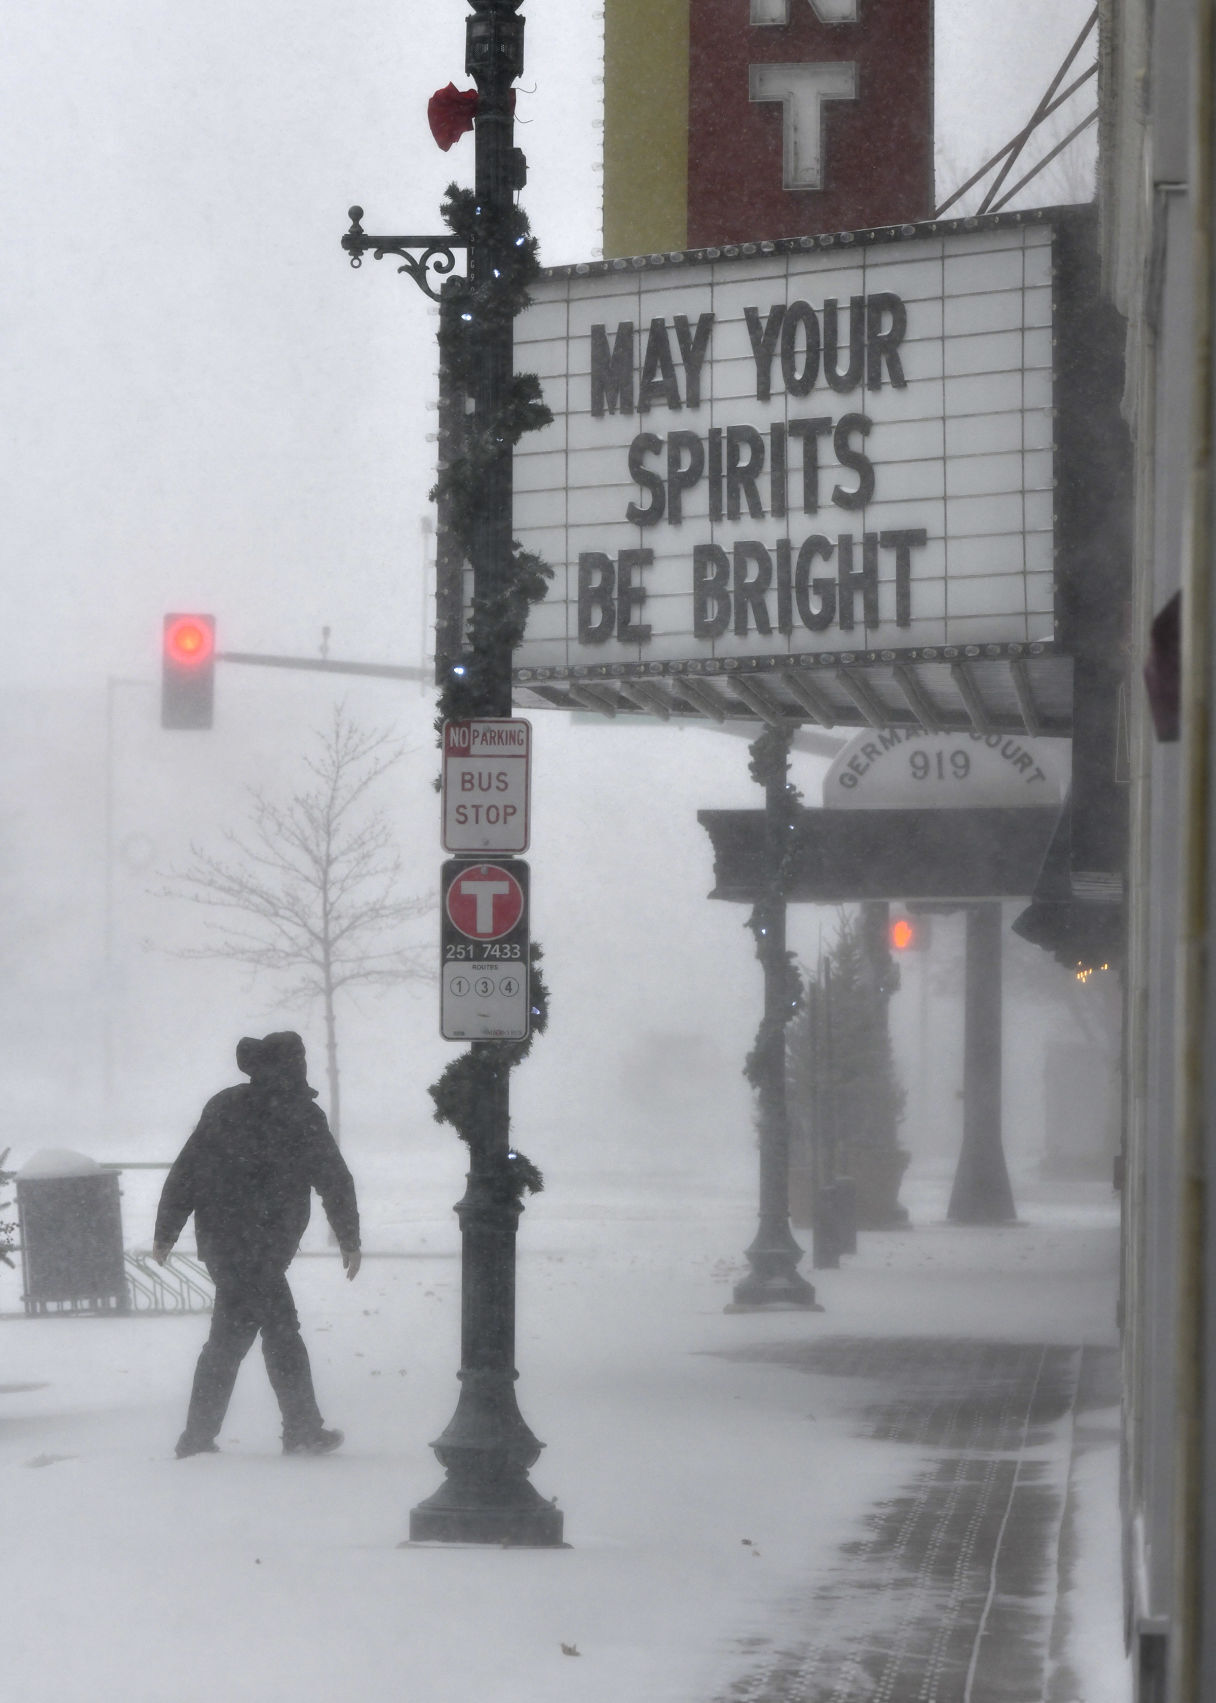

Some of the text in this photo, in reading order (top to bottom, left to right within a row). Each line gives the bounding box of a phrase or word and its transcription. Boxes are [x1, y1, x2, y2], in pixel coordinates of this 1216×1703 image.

[749, 0, 857, 190] T
[590, 292, 907, 417] MAY YOUR
[625, 412, 876, 526] SPIRITS
[578, 528, 928, 644] BE BRIGHT
[450, 727, 524, 747] NO PARKING
[838, 728, 951, 789] GERMA
[909, 750, 970, 780] 919
[461, 772, 509, 791] BUS
[455, 805, 517, 824] STOP
[460, 880, 509, 933] T
[446, 944, 521, 959] 251 7433
[455, 980, 513, 994] 1 3 4
